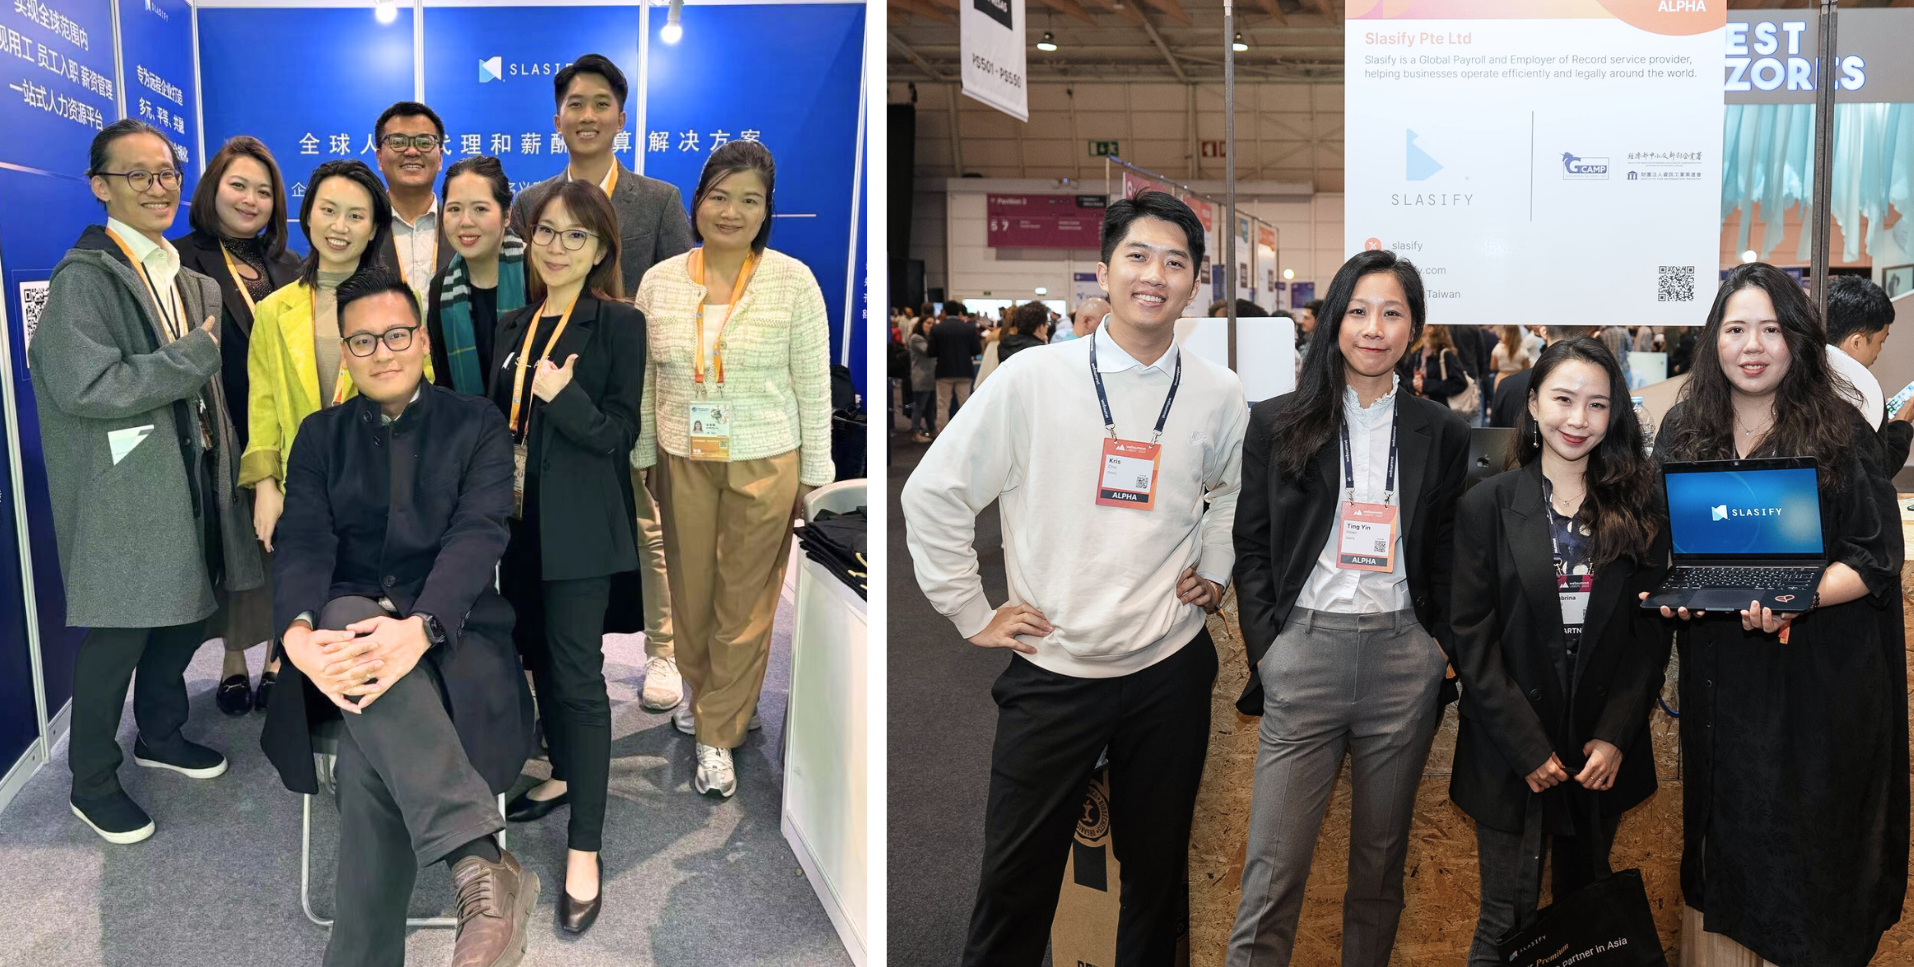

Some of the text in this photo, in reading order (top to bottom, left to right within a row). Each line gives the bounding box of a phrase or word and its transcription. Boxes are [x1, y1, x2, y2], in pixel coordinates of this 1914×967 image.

[1658, 0, 1706, 12] ALPHA
[1365, 32, 1472, 47] Slasify Pte Ltd
[1726, 21, 1807, 55] EST
[1365, 55, 1396, 66] Slasify
[1400, 55, 1407, 64] is
[1419, 55, 1450, 64] Global
[1454, 55, 1486, 66] Payroll
[1489, 55, 1507, 64] and
[1511, 54, 1555, 66] Employer
[1559, 54, 1569, 64] of
[1572, 54, 1607, 64] Record
[1610, 54, 1646, 64] service
[1649, 54, 1692, 66] provider,
[38, 43, 79, 84] 员工入职
[80, 65, 113, 100] 薪资管理
[1365, 68, 1697, 80] helping businesses operate efficiently and legally around the world.
[9, 78, 103, 131] 一站式人力资源平台
[1581, 165, 1606, 173] CAMP
[1391, 194, 1473, 206] SLASIFY
[1392, 241, 1423, 252] slasify
[1417, 267, 1446, 276] y.com
[1427, 290, 1461, 299] Taiwan
[1112, 492, 1137, 501] ALPHA
[1732, 508, 1783, 517] SLASIFY
[1347, 523, 1360, 531] Ting
[1352, 556, 1377, 565] ALPHA
[1595, 944, 1606, 954] in
[1607, 937, 1628, 950] Asia
[1536, 943, 1569, 967] Premium
